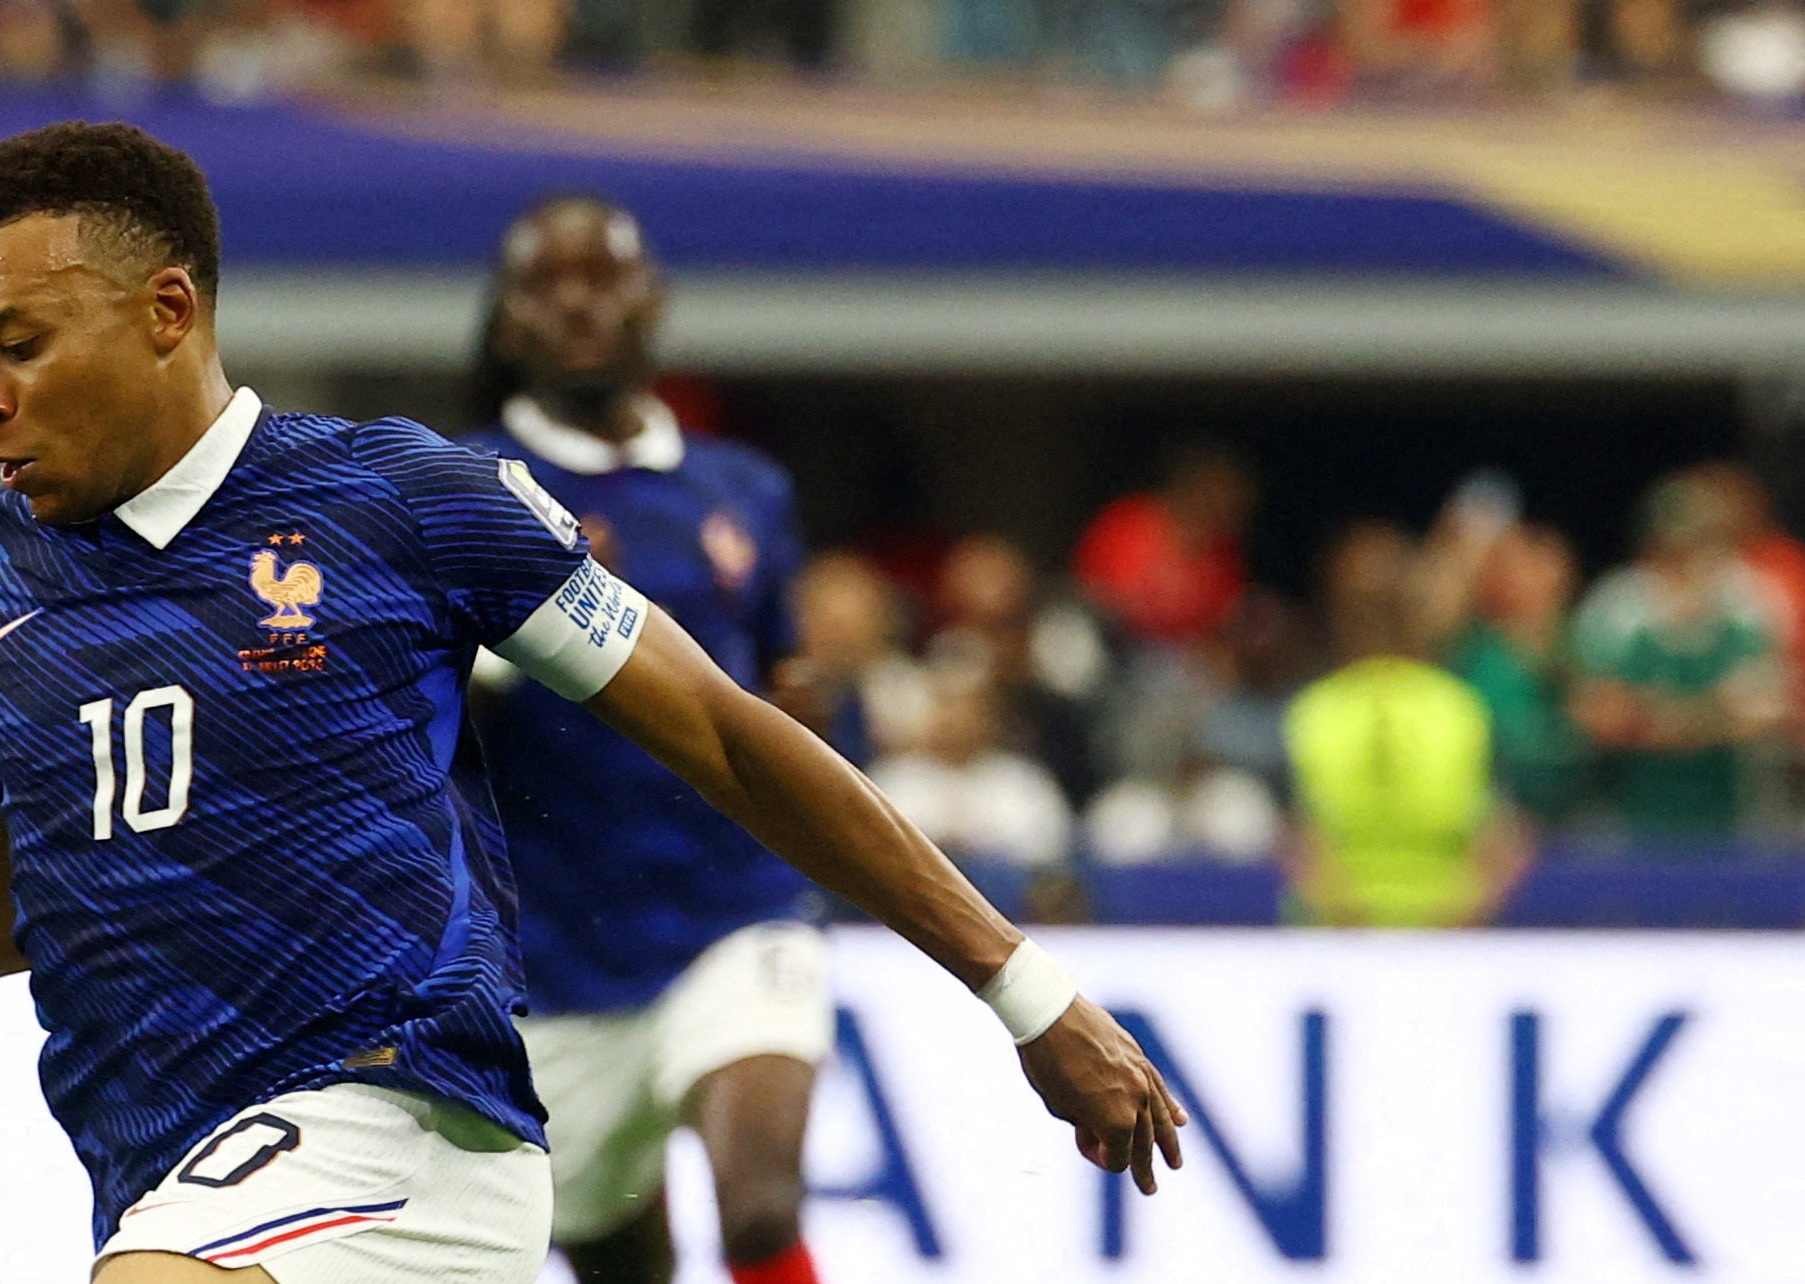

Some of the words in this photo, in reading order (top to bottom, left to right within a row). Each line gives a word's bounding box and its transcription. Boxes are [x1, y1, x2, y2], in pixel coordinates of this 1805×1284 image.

[587, 620, 612, 648] the
[618, 608, 637, 638] FIFA
[79, 684, 195, 841] 10
